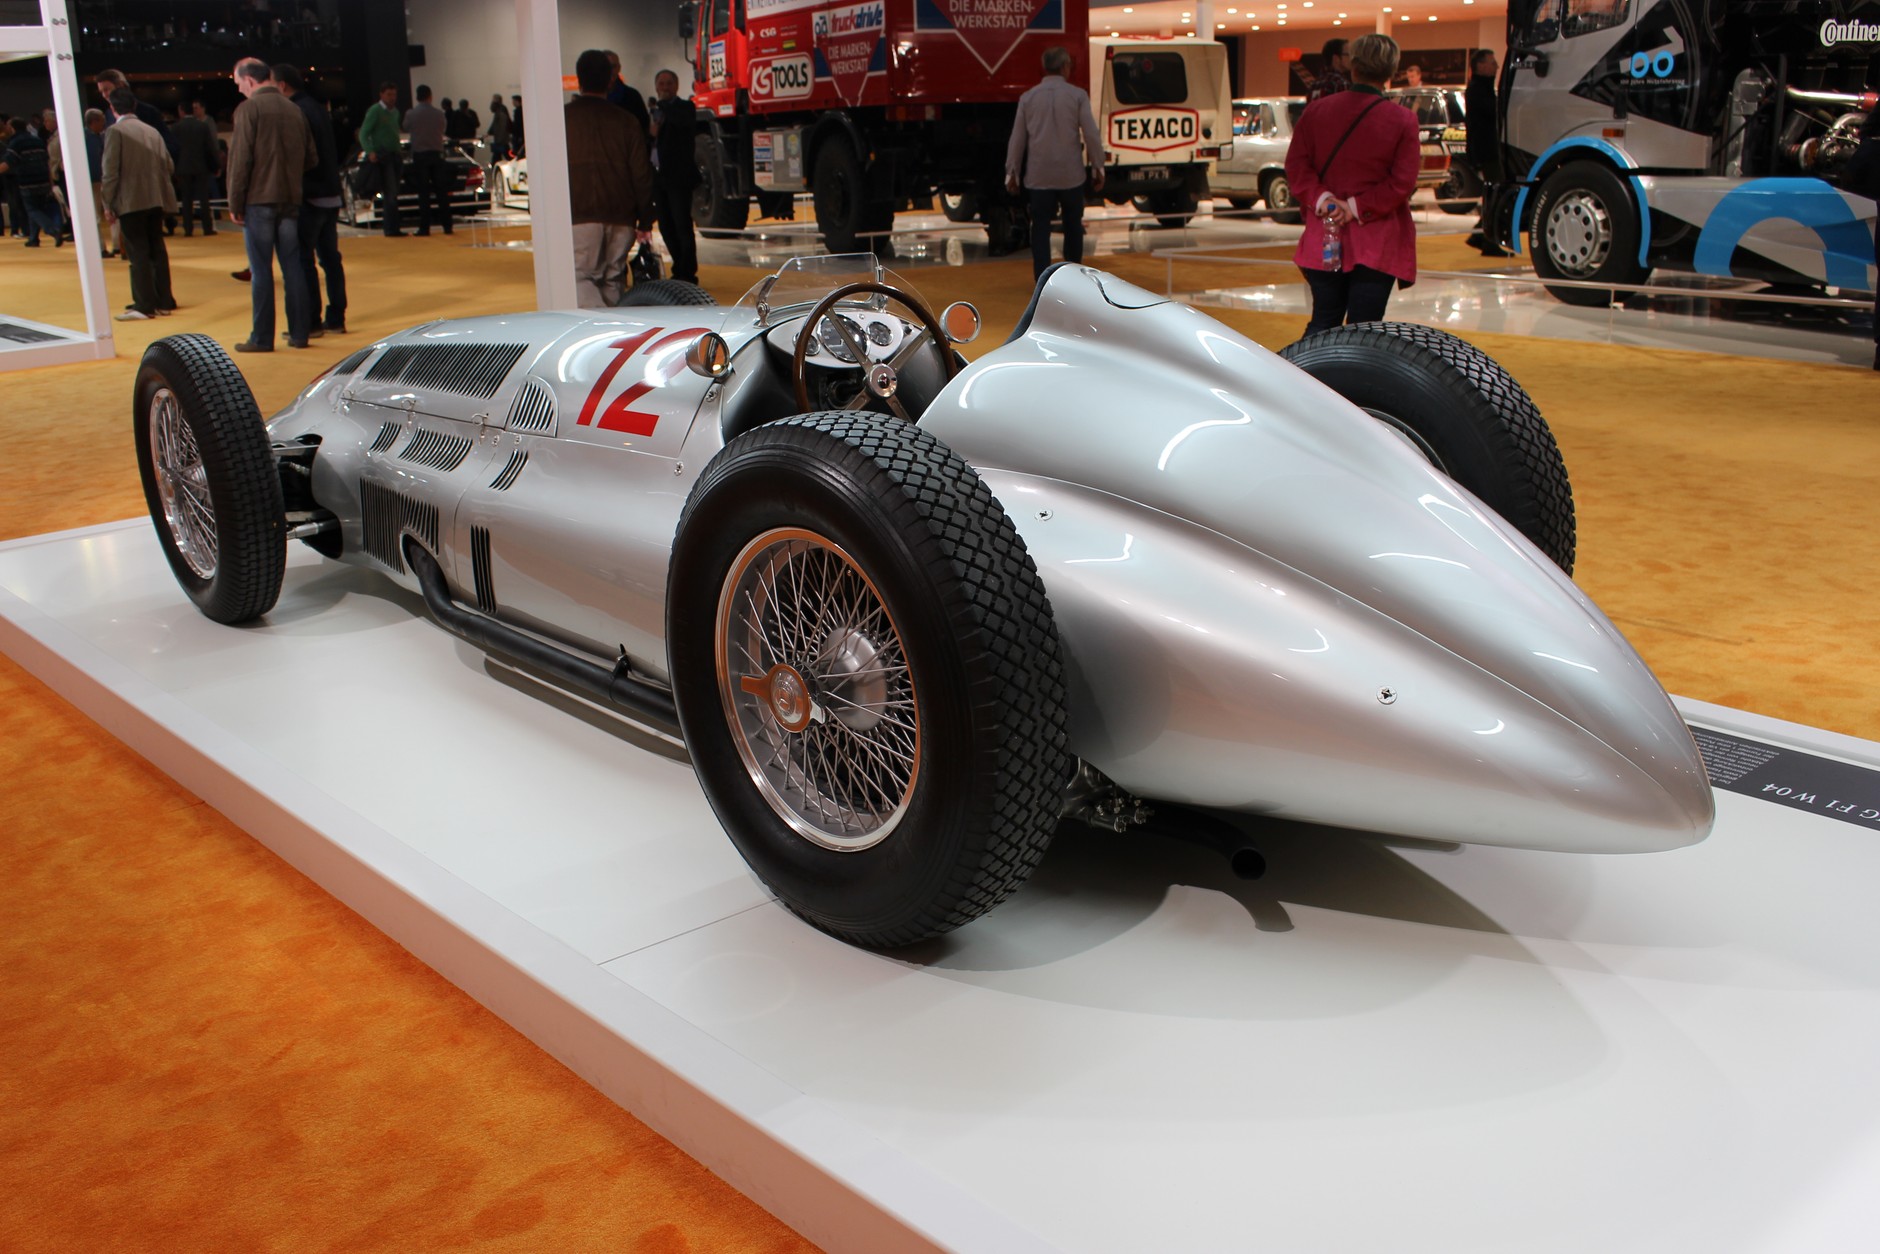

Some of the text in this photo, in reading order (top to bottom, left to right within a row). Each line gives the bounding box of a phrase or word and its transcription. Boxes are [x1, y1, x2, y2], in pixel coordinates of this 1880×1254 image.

[950, 0, 1034, 12] DIE MARKEN-
[832, 4, 883, 32] truckdrive
[953, 15, 1028, 28] WERKSTATT
[760, 27, 777, 39] CSG
[1820, 18, 1880, 47] Contine
[828, 42, 872, 60] DIE MARKEN-
[831, 58, 869, 75] WERKSTATT
[752, 63, 808, 95] KS TOOLS
[1114, 117, 1193, 140] TEXACO
[576, 327, 713, 437] 12
[1825, 800, 1858, 814] F1
